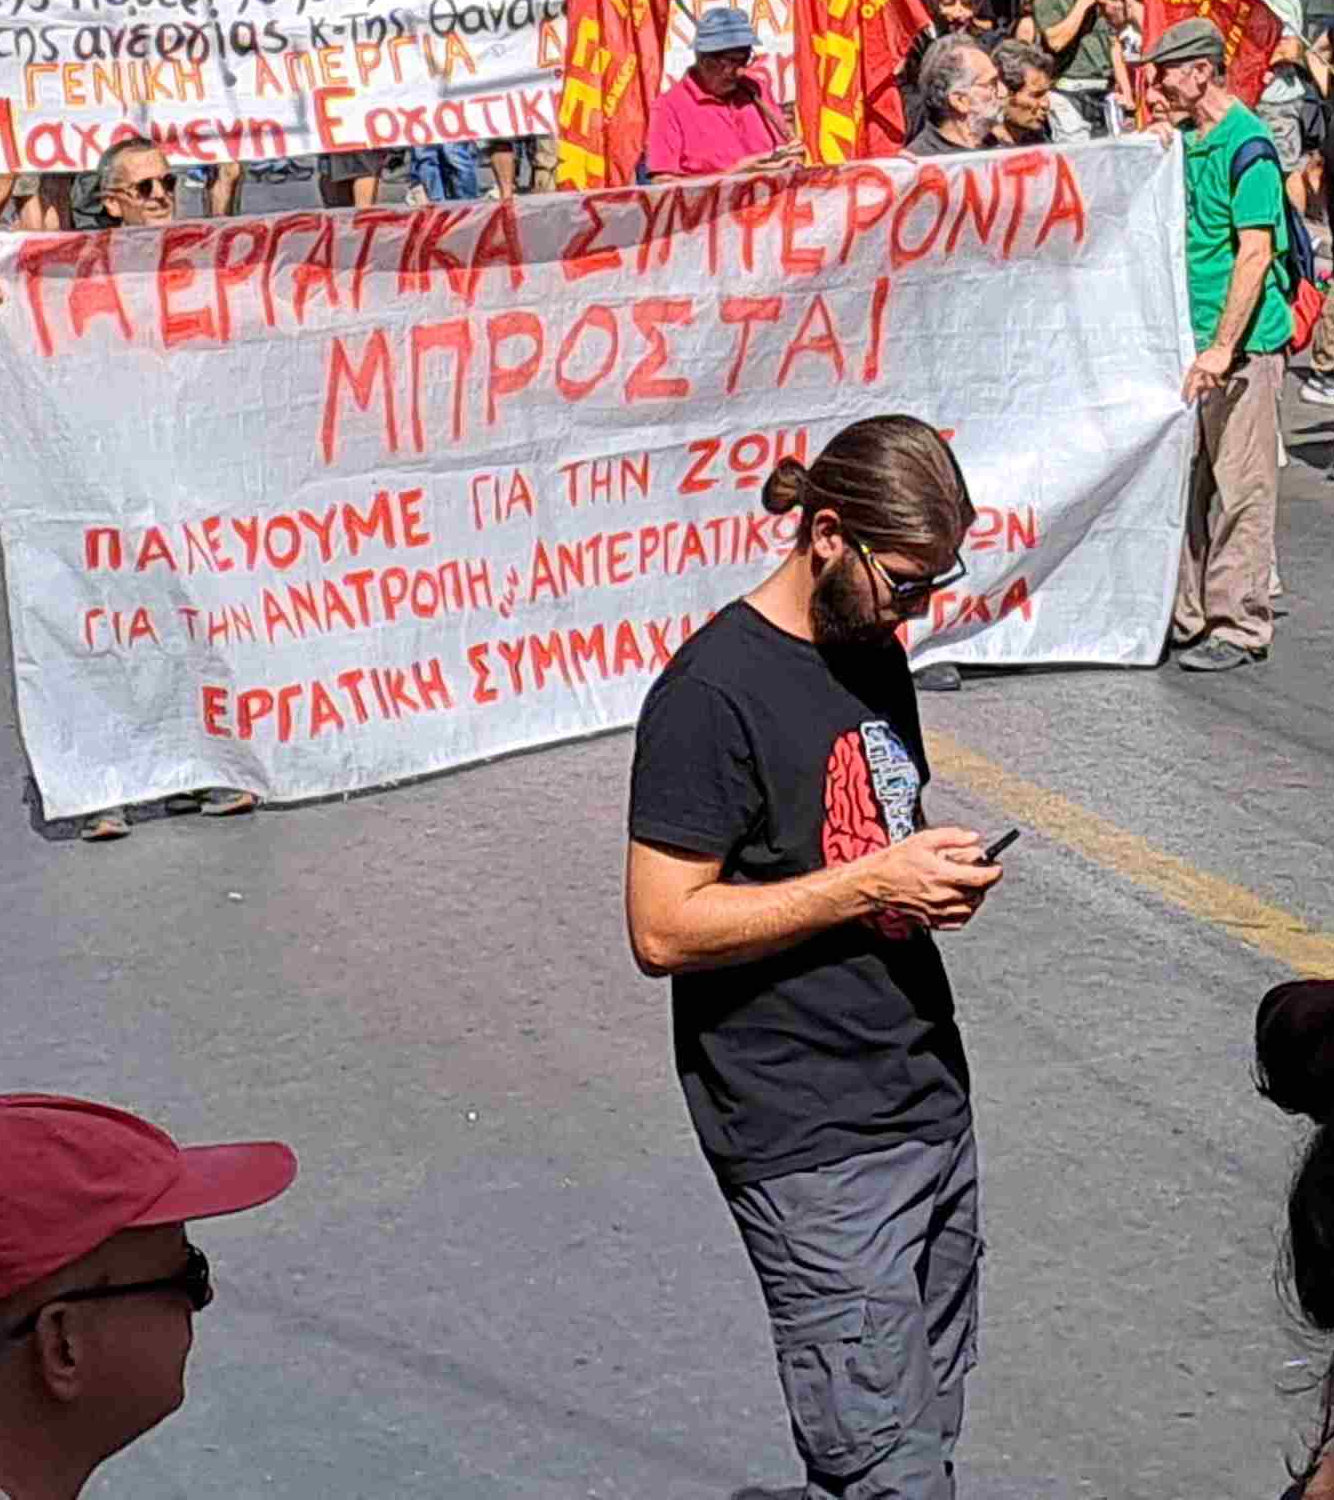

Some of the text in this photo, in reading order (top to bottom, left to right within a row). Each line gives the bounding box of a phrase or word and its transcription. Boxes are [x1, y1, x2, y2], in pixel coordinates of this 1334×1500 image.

[23, 31, 476, 113] ΓΕΝΙΚΗ ΑΠΕΡΓΙΑ
[16, 149, 1091, 356] ΤΑ ΕΡΓΑΤΙΚΑ ΣΥΜΦΕΡΟΝΤΑ
[83, 486, 431, 574] ΠΑΛΕΥΟΥΜΕ
[468, 468, 534, 530] ΓΙΑ
[559, 452, 650, 510] ΤΗΝ
[84, 607, 162, 647] ΓΙΑ
[172, 604, 257, 647] ΤΗΝ
[261, 558, 494, 644] ΑΝΑΤΡΟΠΗ
[201, 656, 454, 743] ΕΡΓΑΤΙΚΗ
